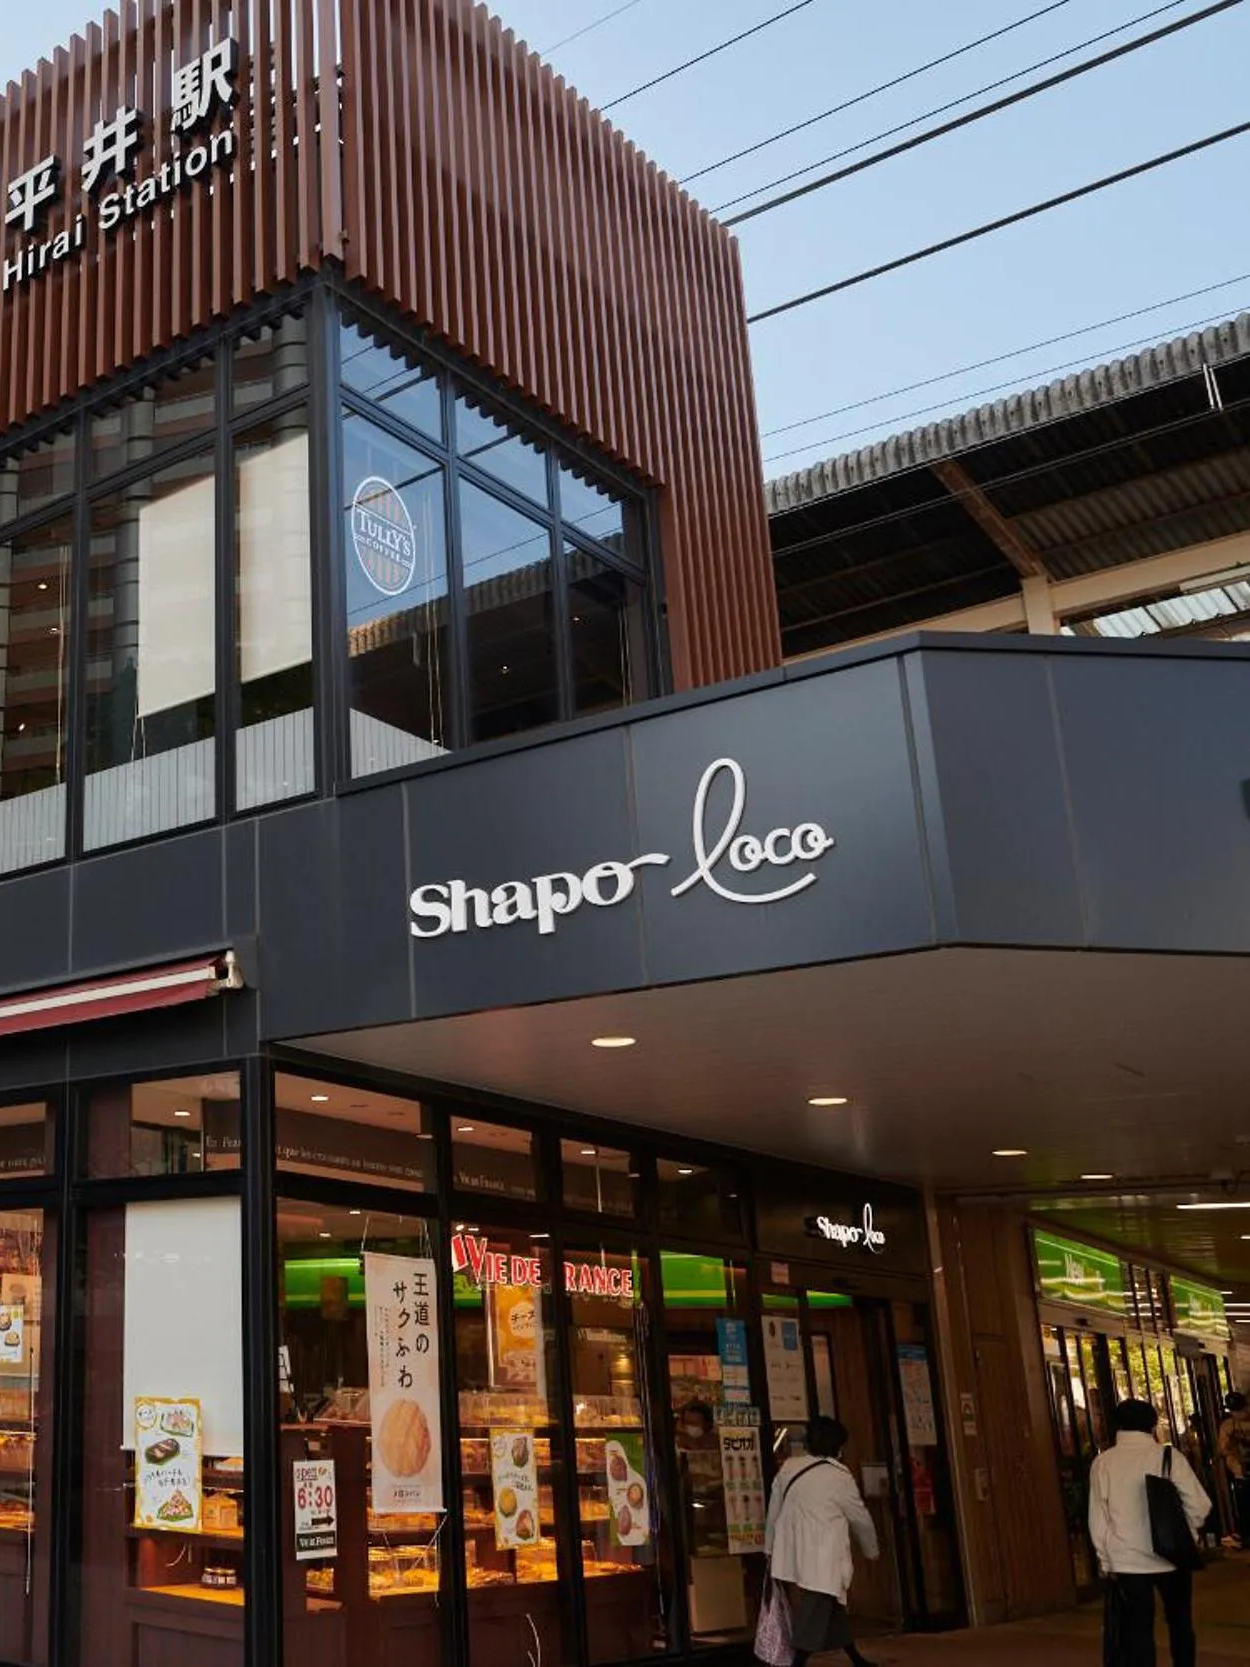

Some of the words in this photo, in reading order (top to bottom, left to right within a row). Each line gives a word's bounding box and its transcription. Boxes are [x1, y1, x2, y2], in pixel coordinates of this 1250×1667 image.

[5, 38, 234, 232] 平井駅
[3, 215, 84, 290] Hirai
[99, 129, 233, 230] Station
[413, 1273, 431, 1354] 王道の
[562, 1260, 636, 1299] RANCE
[392, 1280, 414, 1388] サクふわ
[298, 1485, 334, 1510] 6:30
